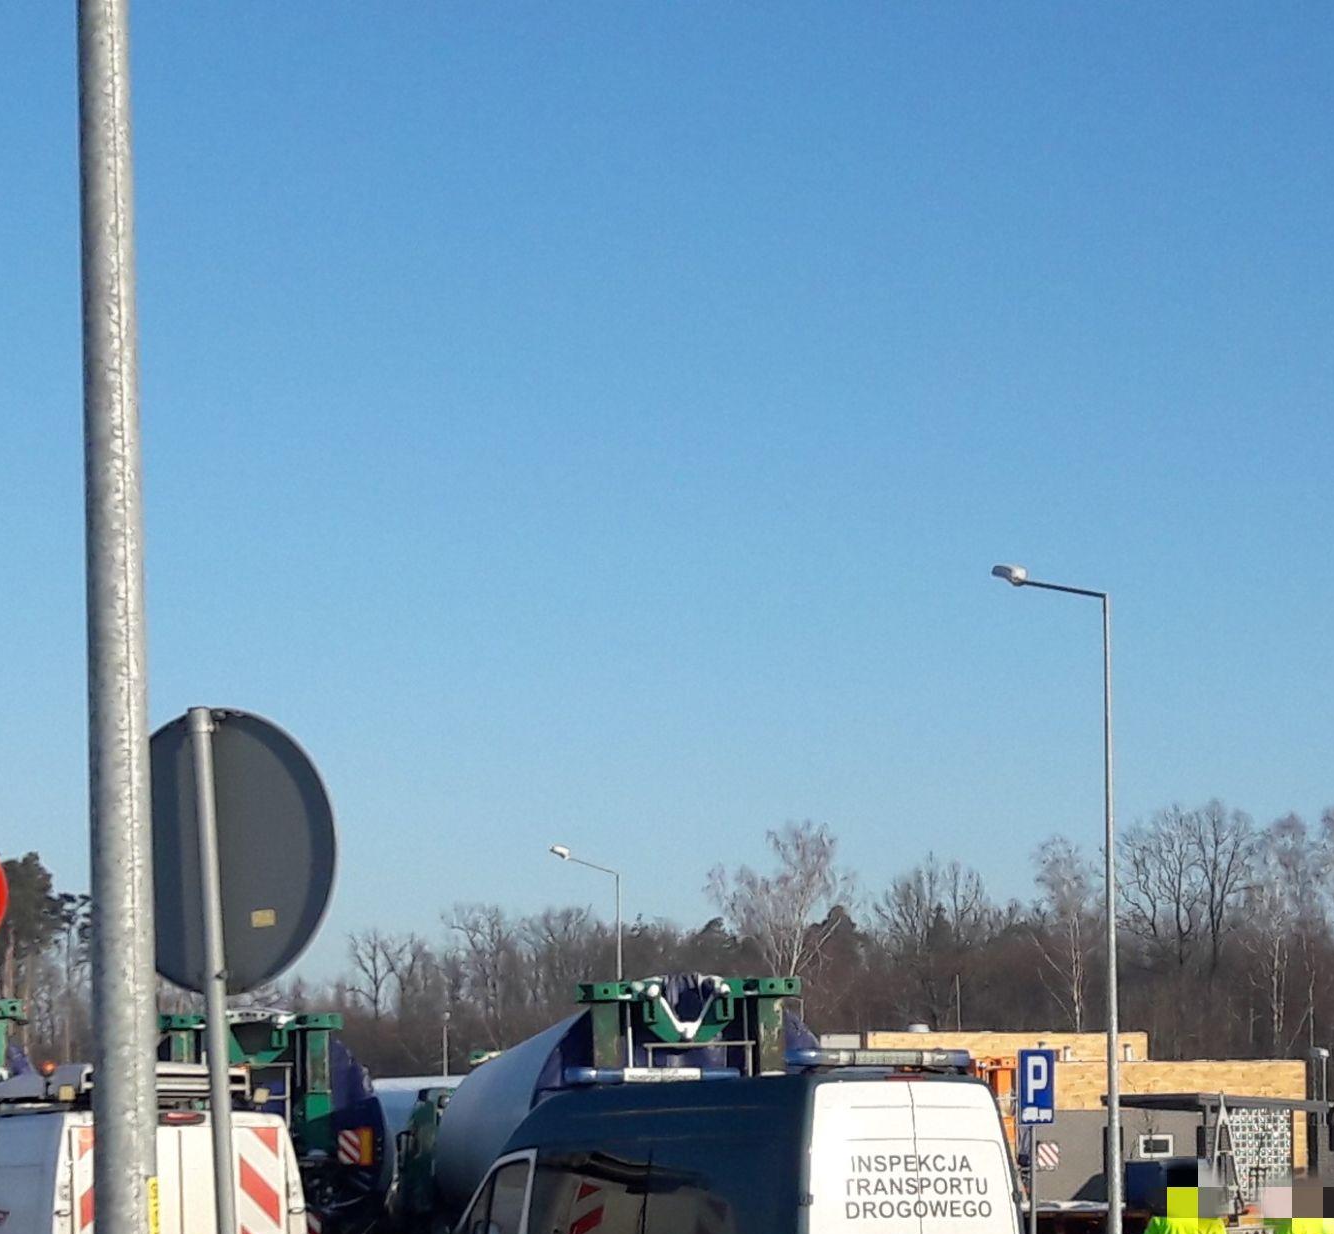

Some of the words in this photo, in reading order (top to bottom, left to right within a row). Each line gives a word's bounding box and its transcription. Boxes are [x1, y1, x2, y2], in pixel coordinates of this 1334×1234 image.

[1027, 1055, 1048, 1104] P
[851, 1154, 972, 1173] INSPEKCJA
[845, 1177, 988, 1196] TRANSPORTU
[845, 1200, 992, 1219] DROGOWEGO
